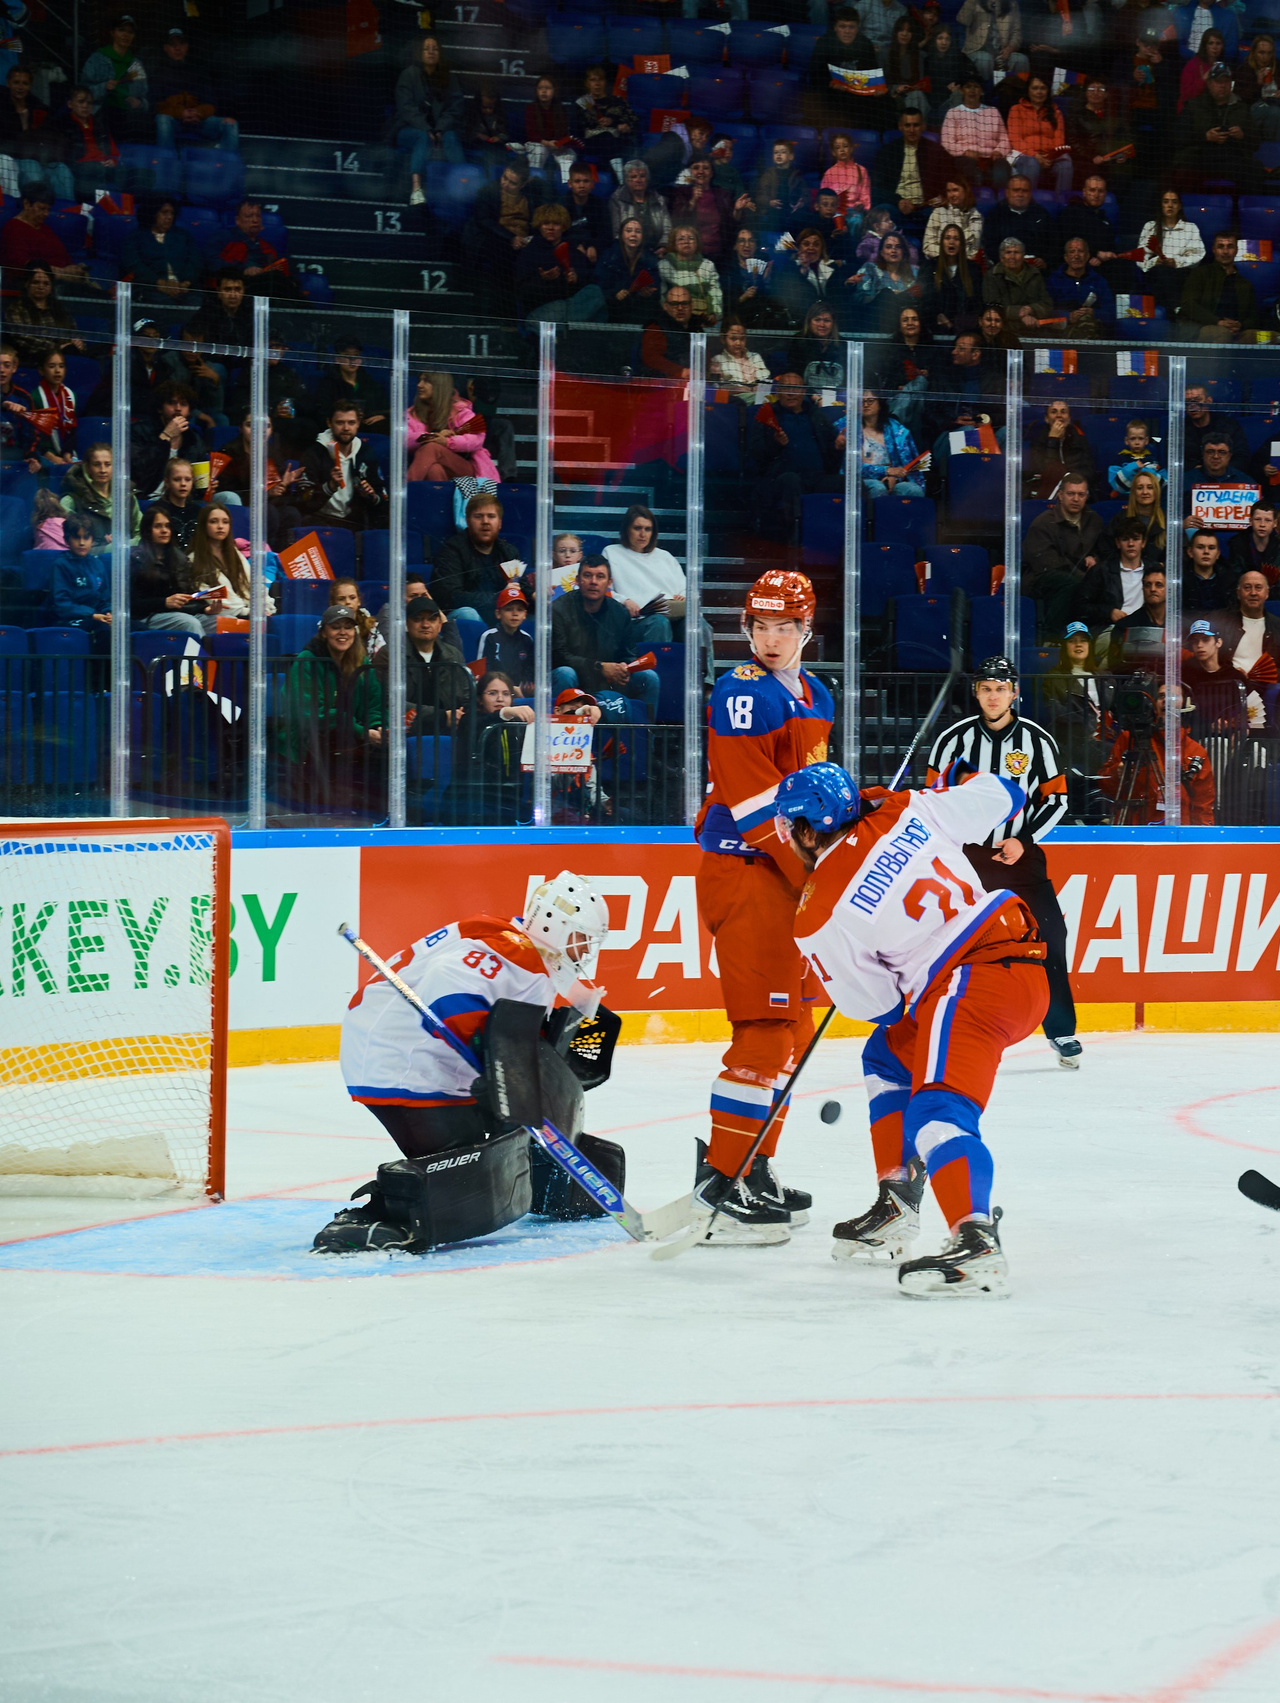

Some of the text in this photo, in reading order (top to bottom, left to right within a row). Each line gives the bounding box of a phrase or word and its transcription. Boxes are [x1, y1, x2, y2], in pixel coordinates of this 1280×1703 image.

[454, 5, 479, 23] 17
[500, 58, 525, 77] 16
[333, 151, 360, 172] 14
[374, 210, 402, 232] 13
[420, 269, 448, 292] 12
[467, 334, 489, 357] 11
[753, 600, 784, 609] РОЛЬФ
[726, 695, 754, 730] 18
[787, 805, 804, 813] CCM
[849, 817, 932, 915] ПОЛУВЫТНОВ
[0, 892, 299, 998] KEY.BY
[462, 950, 503, 980] 83
[425, 1151, 482, 1174] BAUER
[540, 1124, 619, 1207] BAUER
